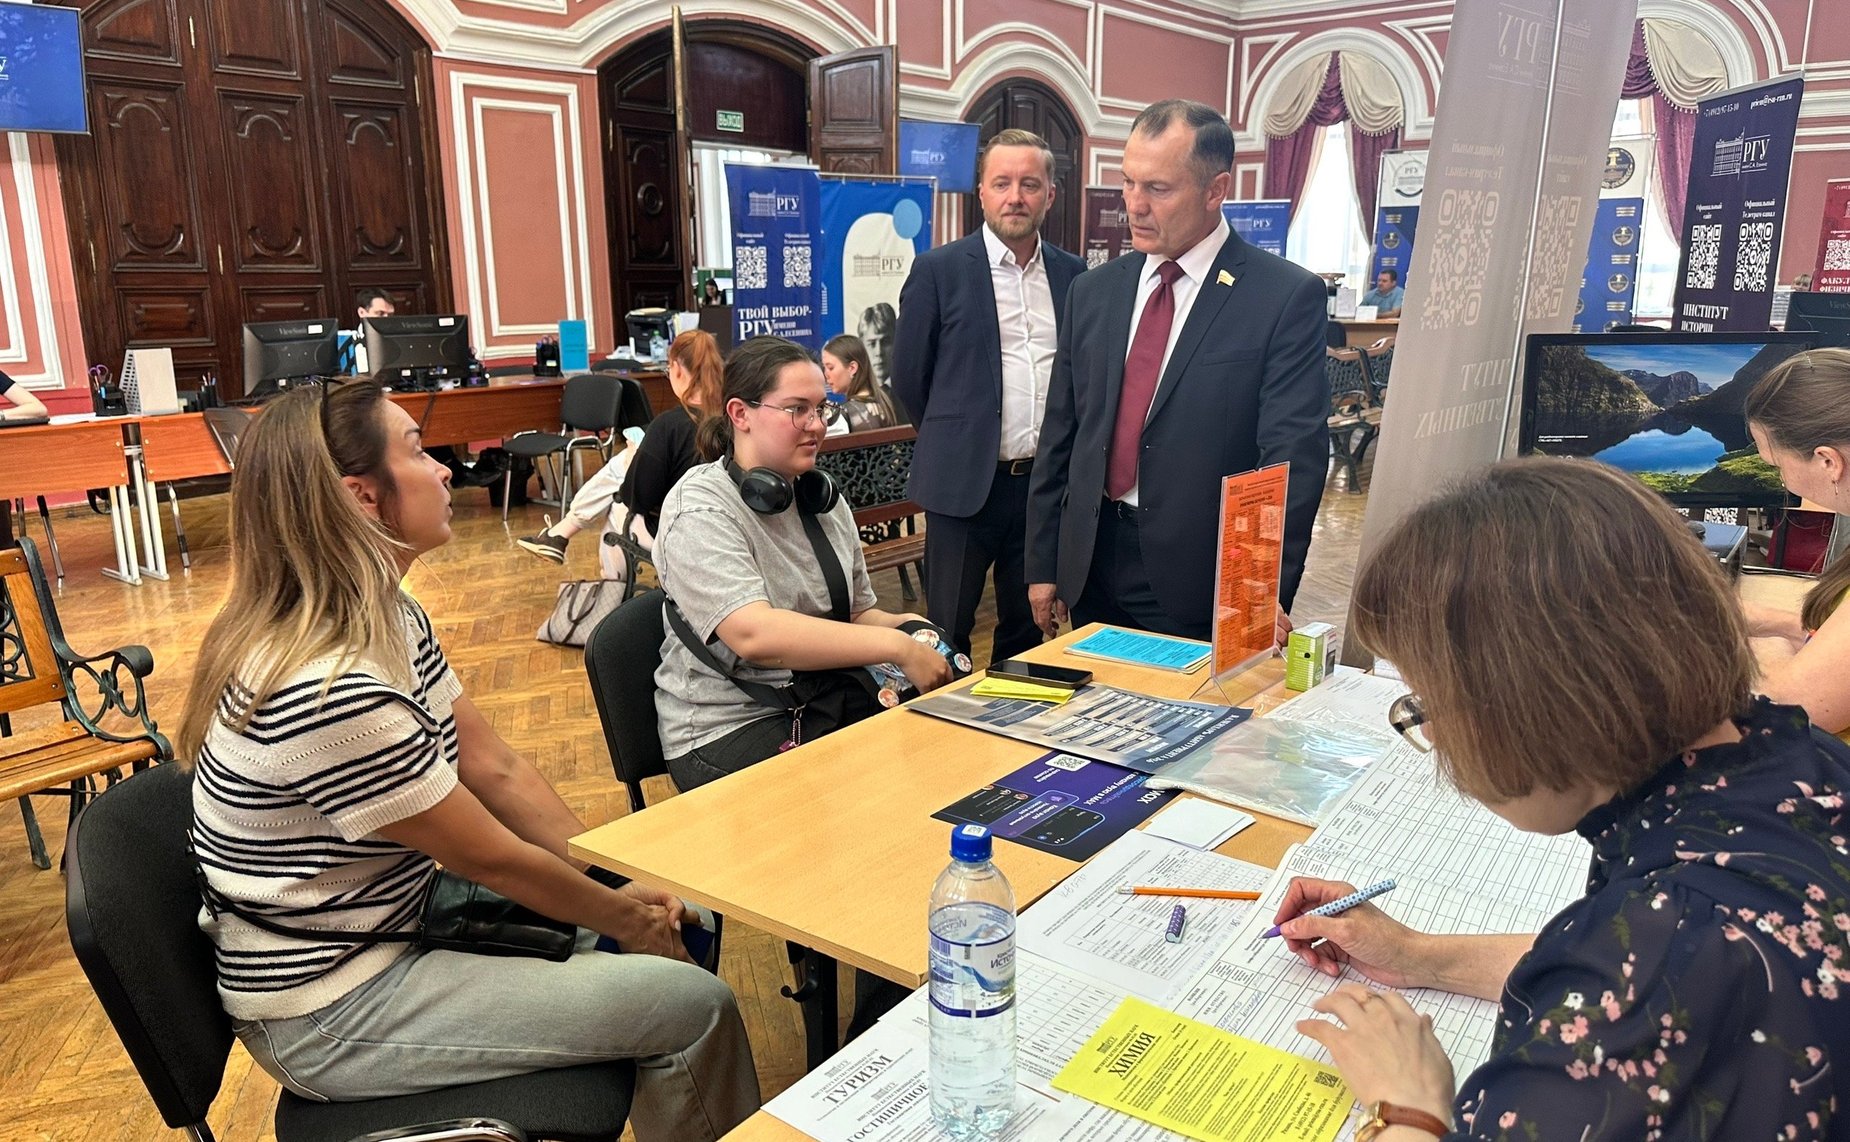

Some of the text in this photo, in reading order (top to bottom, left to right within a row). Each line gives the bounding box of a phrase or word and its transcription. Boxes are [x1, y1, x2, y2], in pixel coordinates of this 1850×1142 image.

[1742, 138, 1771, 163] РГУ
[776, 196, 800, 212] РГУ
[1253, 219, 1273, 229] РГУ
[881, 258, 905, 271] РГУ
[737, 304, 812, 320] ТВОЙ ВЫБОР-
[1682, 303, 1729, 320] ИНСТИТУТ
[738, 319, 776, 341] РГУ
[1108, 1032, 1156, 1078] ХИМИЯ
[822, 1055, 892, 1104] ТУРИЗМ
